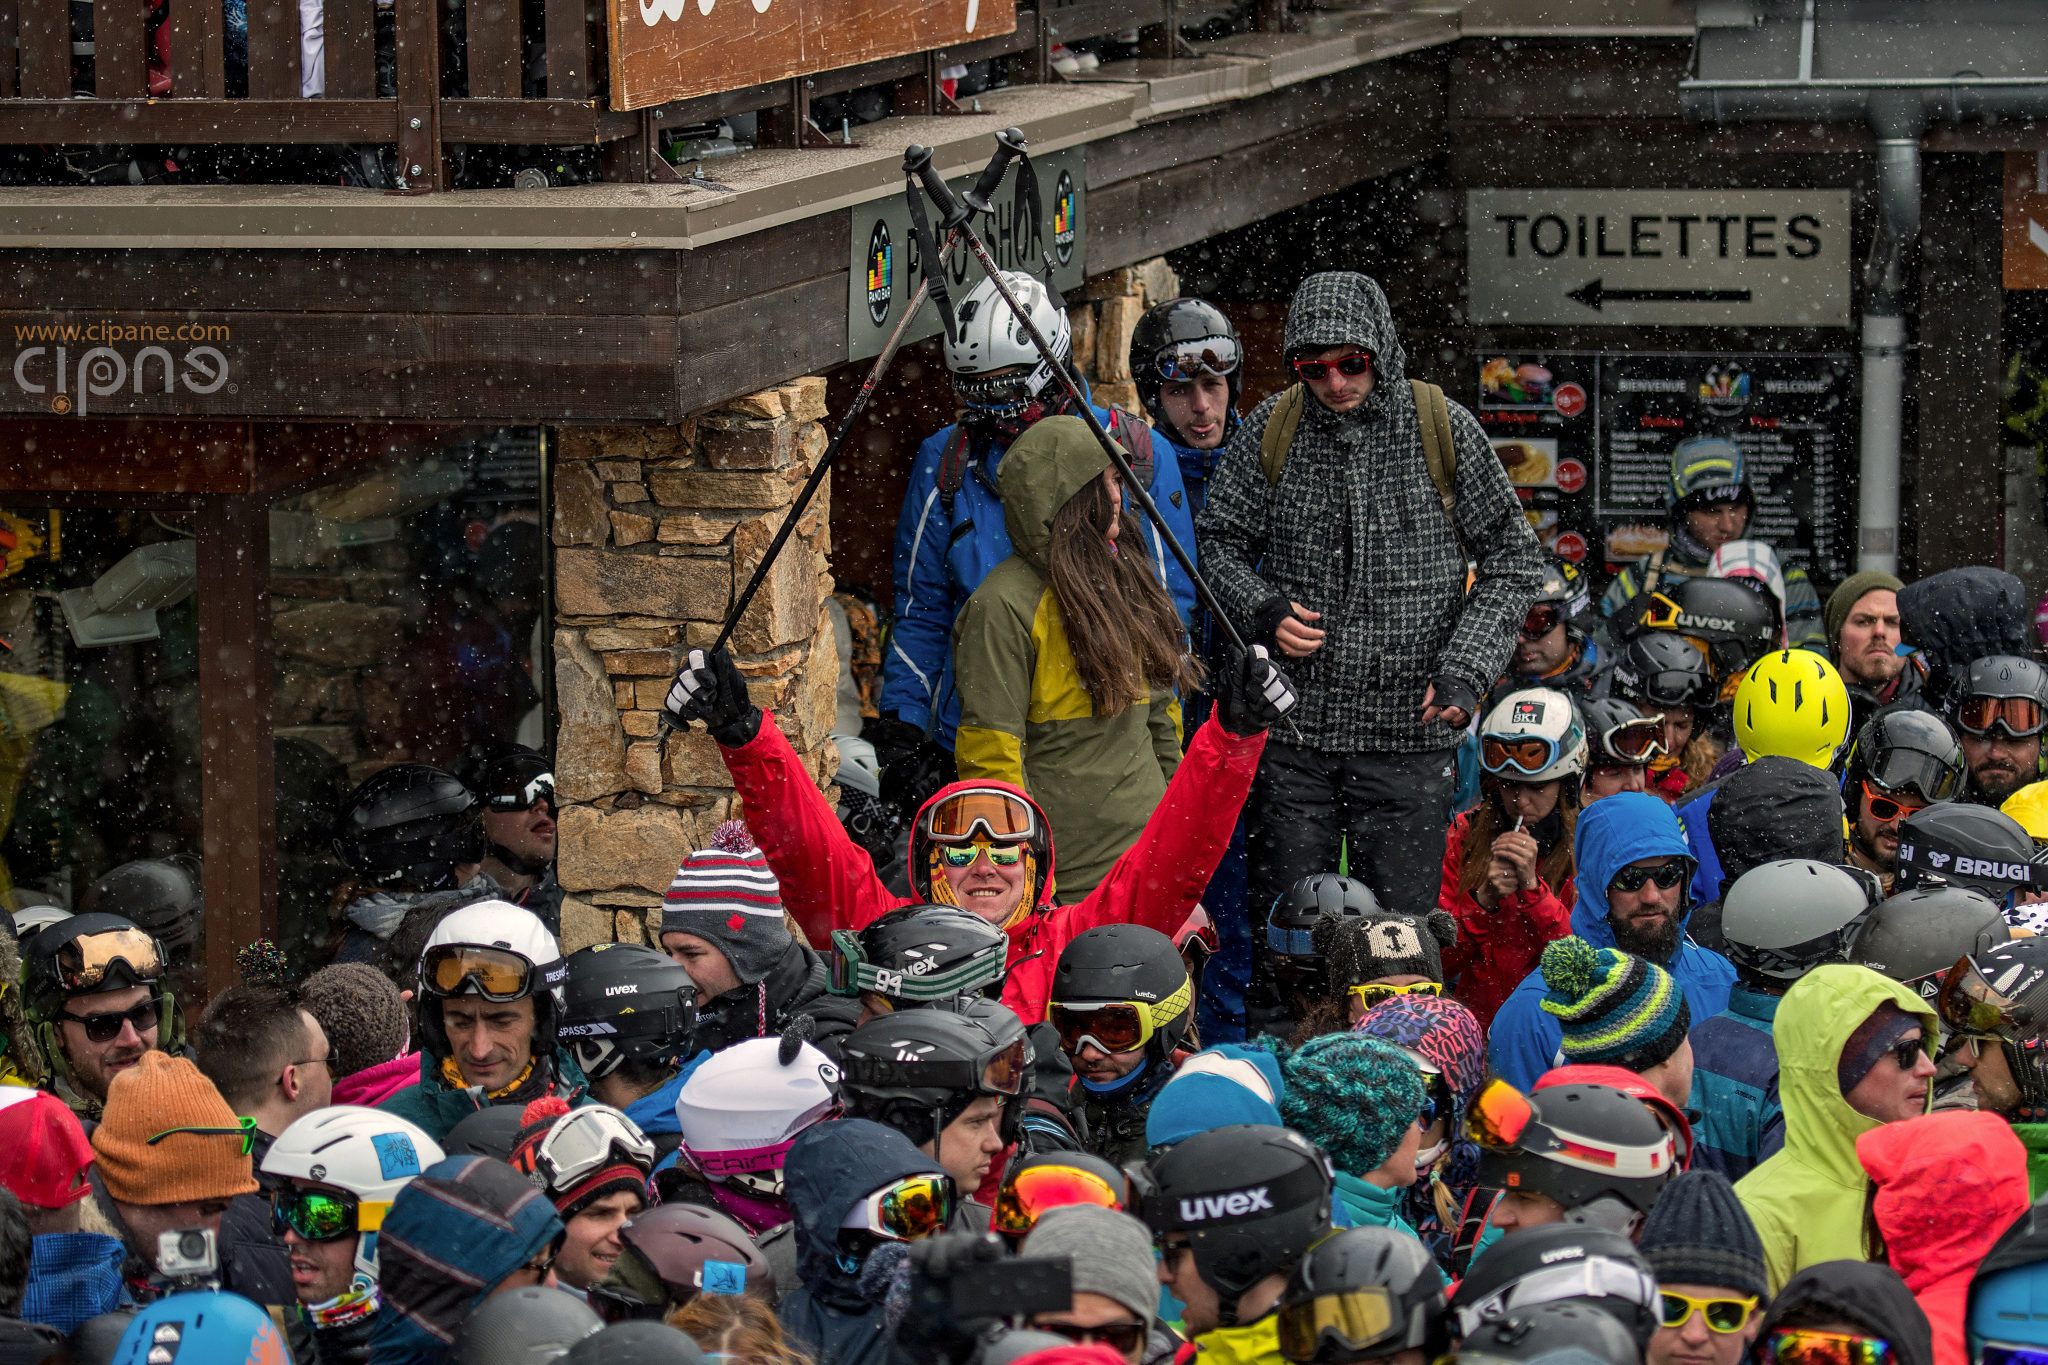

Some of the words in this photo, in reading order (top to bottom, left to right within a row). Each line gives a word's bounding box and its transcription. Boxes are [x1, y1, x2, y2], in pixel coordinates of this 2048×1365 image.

[1495, 213, 1822, 259] TOILETTES
[869, 289, 881, 303] PANO
[881, 286, 891, 300] BAR
[1764, 380, 1826, 393] WELCOME
[1677, 612, 1736, 632] uvex
[1513, 713, 1537, 723] SKI
[1954, 856, 2031, 882] BRUGI
[898, 956, 939, 976] vex
[605, 984, 639, 997] uvex
[874, 969, 903, 997] 94
[1180, 1186, 1274, 1222] uvex
